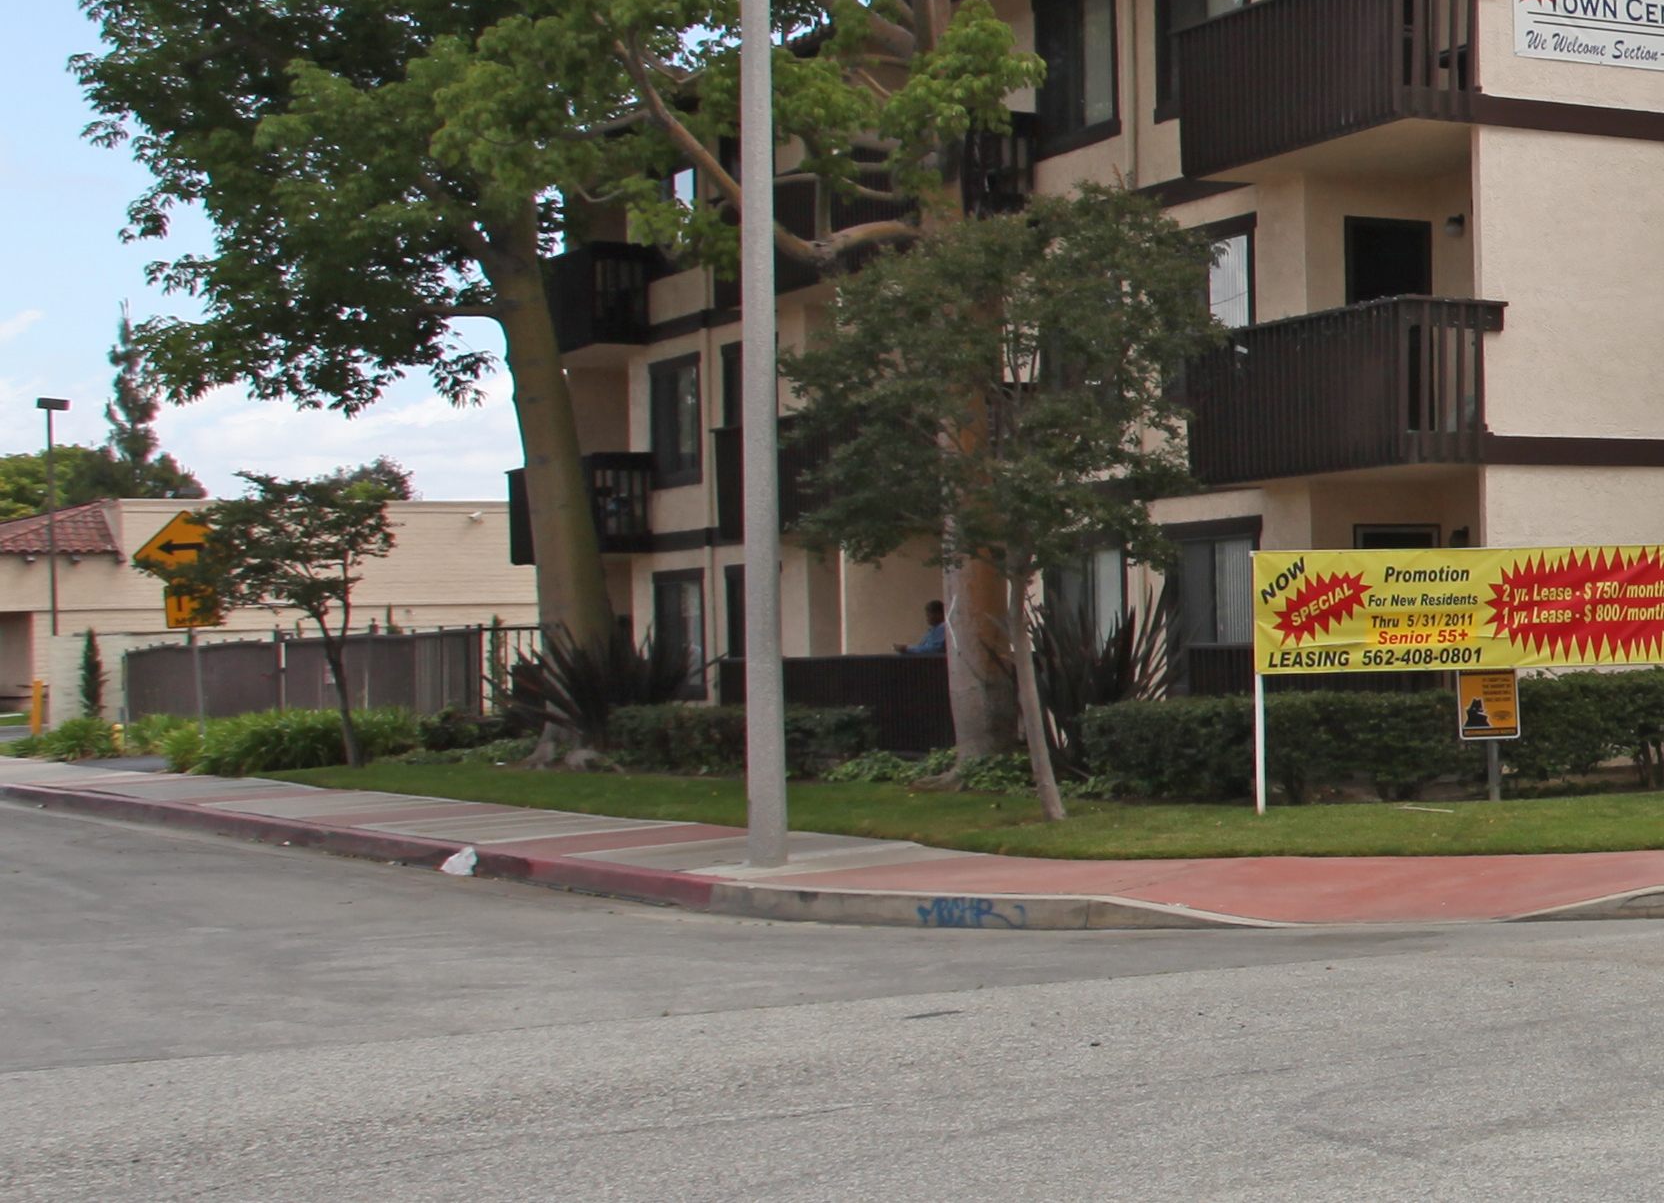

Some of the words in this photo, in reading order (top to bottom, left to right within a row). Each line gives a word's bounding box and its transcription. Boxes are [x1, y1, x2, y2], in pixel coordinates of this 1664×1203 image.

[1526, 30, 1547, 50] We
[1552, 33, 1606, 57] Welcome
[1260, 556, 1306, 605] NOW
[1384, 565, 1470, 583] Promotion
[1290, 582, 1354, 626] SPECIAL
[1368, 594, 1387, 607] For
[1390, 594, 1417, 607] New
[1420, 593, 1478, 606] Residents
[1502, 584, 1511, 602] 2
[1513, 587, 1529, 606] yr.
[1533, 584, 1572, 601] Lease
[1371, 615, 1399, 628] Thru
[1407, 613, 1474, 627] 5/31/2011
[1502, 607, 1509, 625] 1
[1513, 610, 1529, 629] yr.
[1532, 606, 1572, 624] Lease
[1378, 630, 1432, 645] Senior
[1437, 629, 1469, 644] 55+
[1268, 651, 1350, 668] LEASING
[1362, 647, 1482, 666] 562-408-0801
